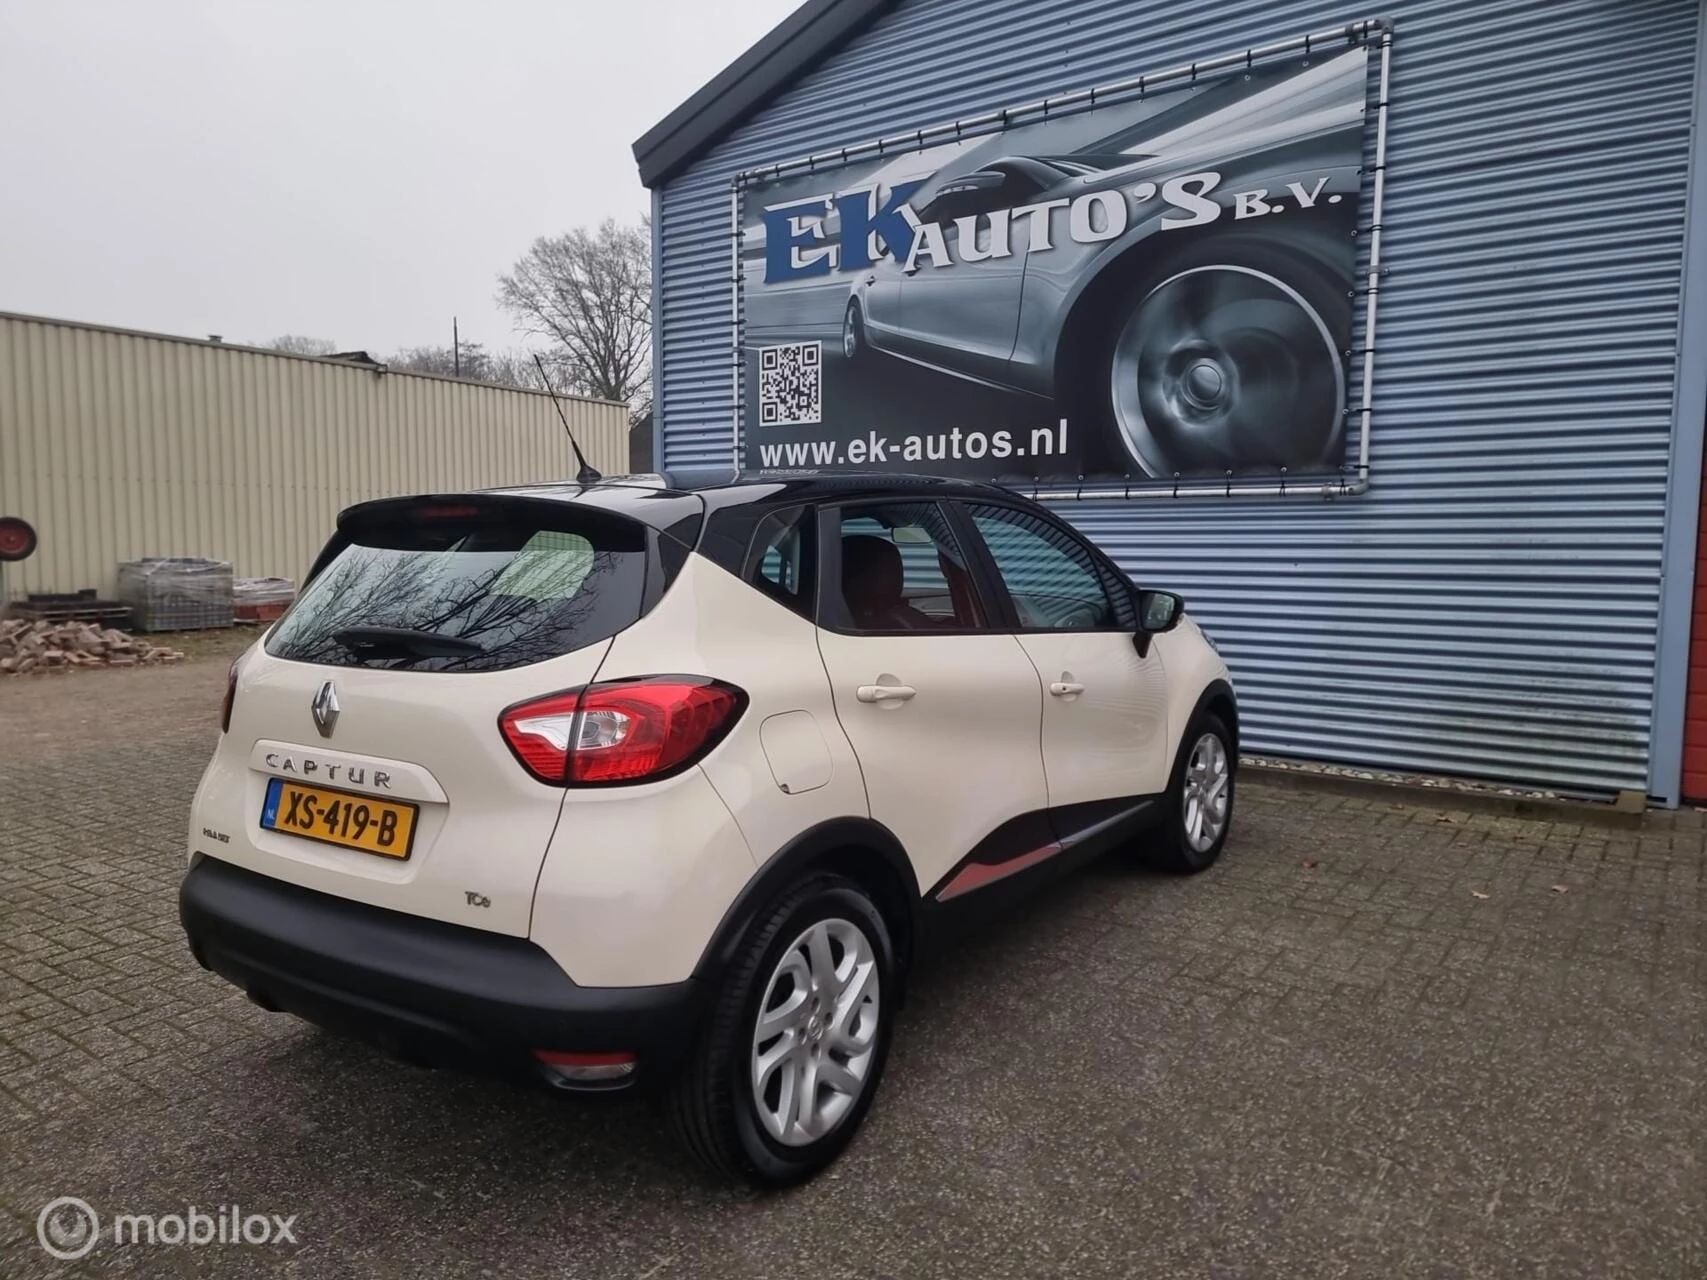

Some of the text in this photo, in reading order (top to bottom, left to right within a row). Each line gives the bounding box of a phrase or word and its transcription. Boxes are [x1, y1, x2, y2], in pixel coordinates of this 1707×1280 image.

[763, 170, 1342, 284] EK AUTO'S B.V.
[760, 418, 1068, 468] www.ek-autos.nl
[265, 752, 392, 790] CAPTUR
[283, 790, 398, 848] XS-419-B
